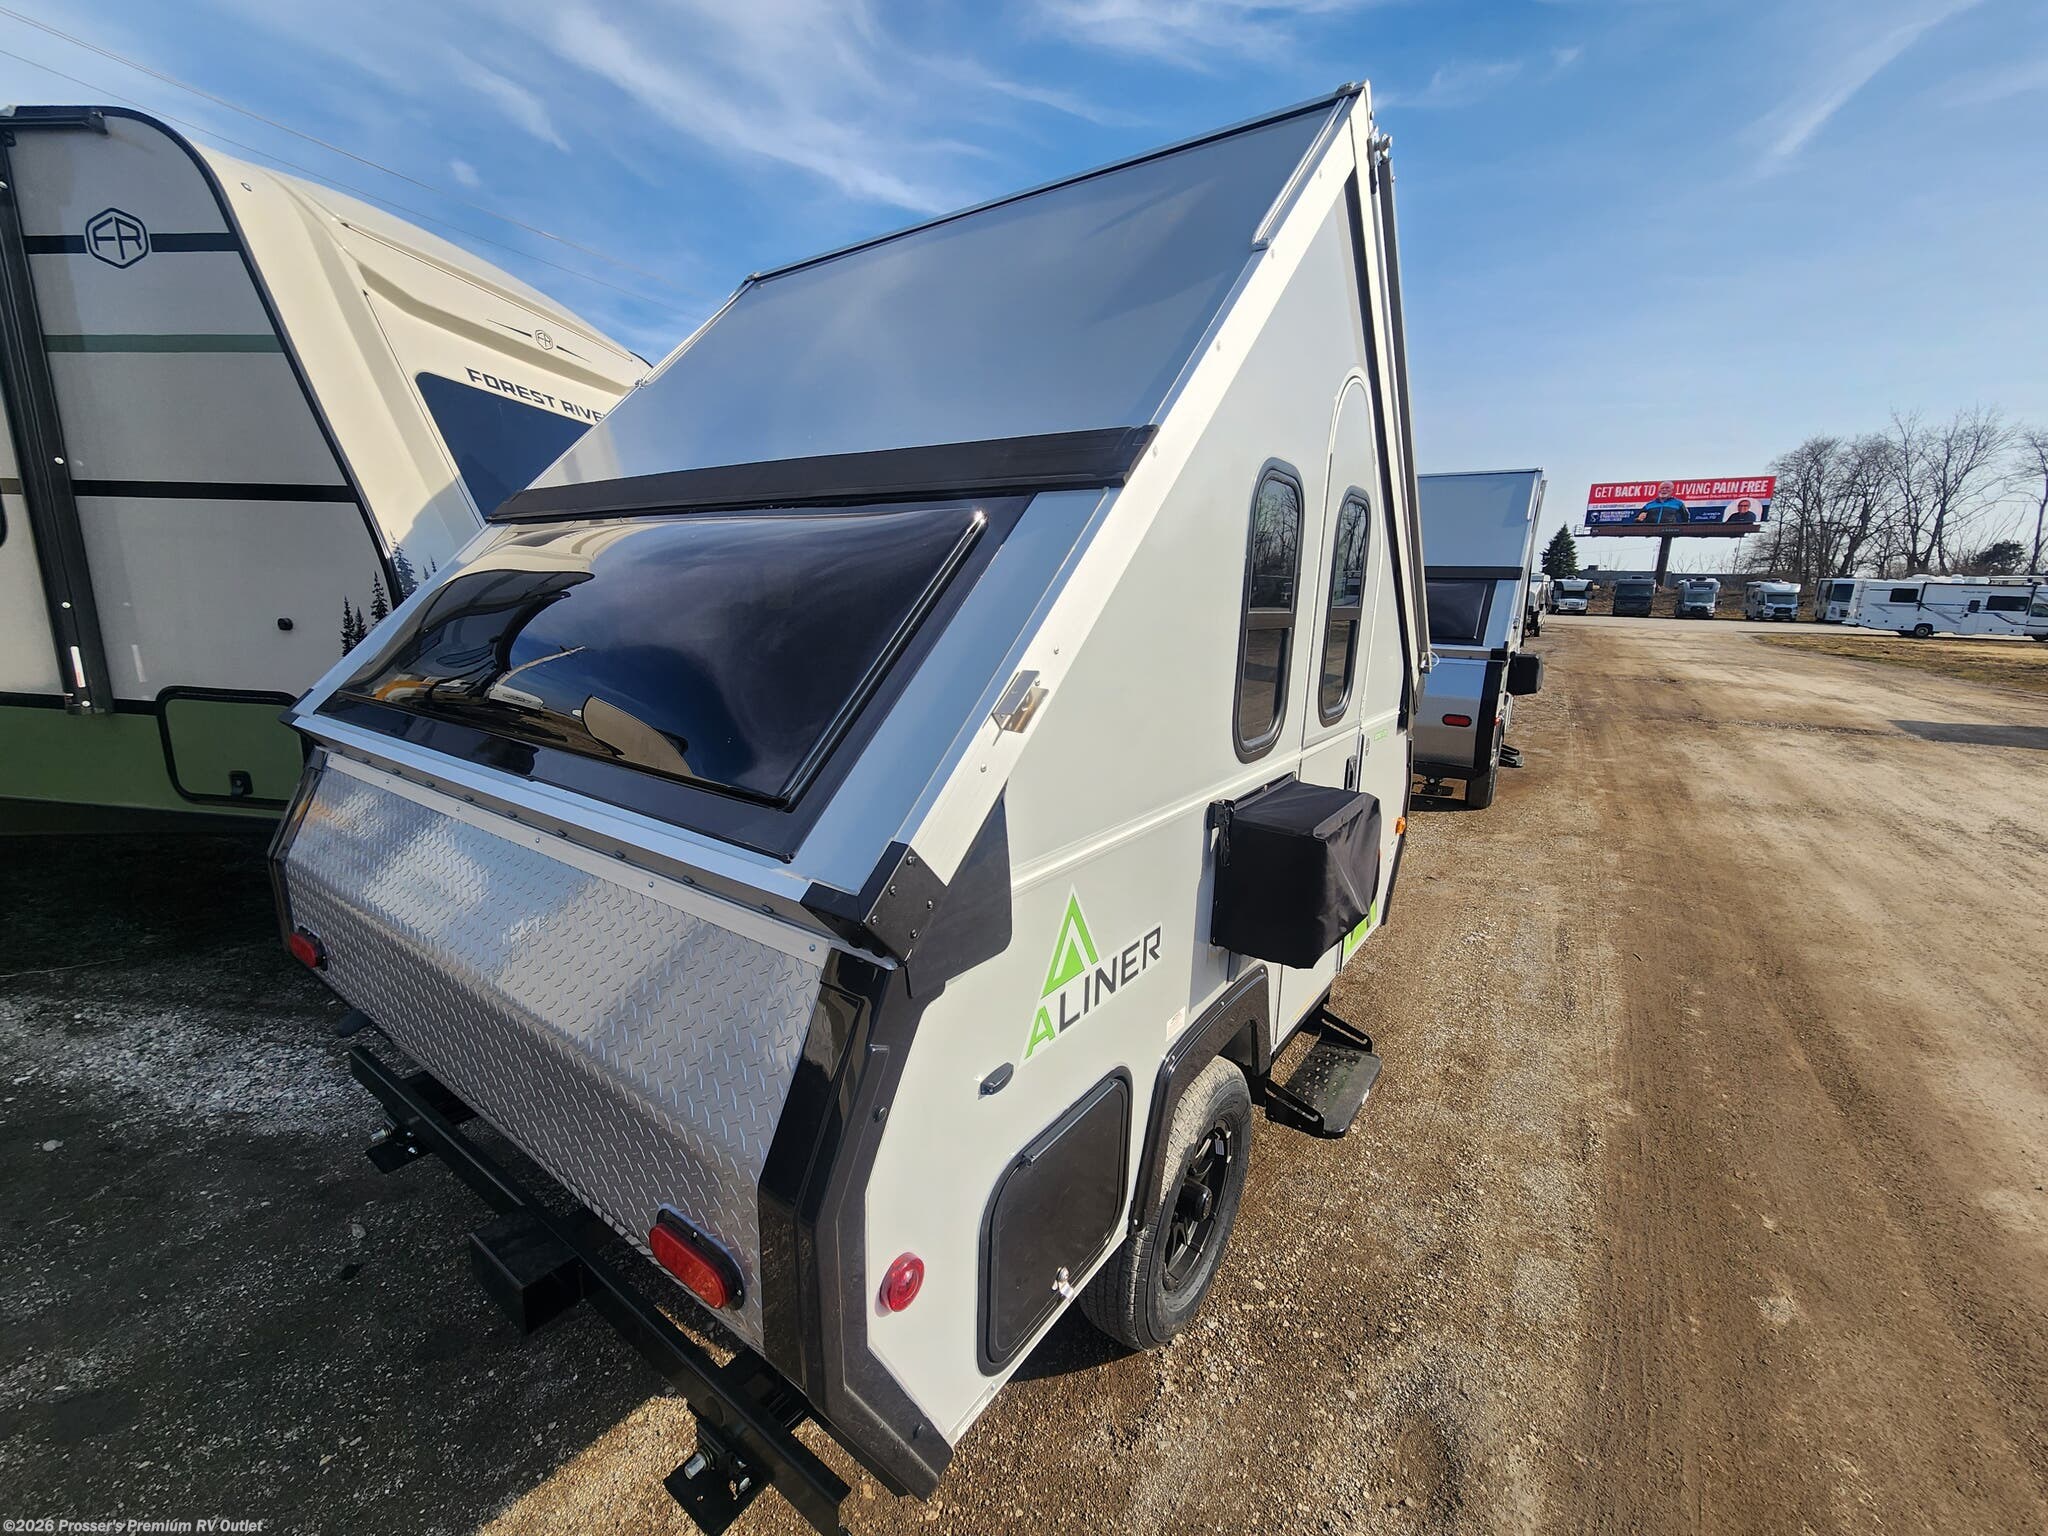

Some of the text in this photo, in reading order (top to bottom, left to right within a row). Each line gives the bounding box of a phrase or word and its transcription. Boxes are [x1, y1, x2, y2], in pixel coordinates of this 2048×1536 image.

[465, 367, 606, 422] FOREST RIVE
[1595, 486, 1613, 498] GET
[1614, 485, 1642, 497] BACK
[1643, 484, 1657, 496] TO
[1675, 482, 1711, 496] LIVING
[1712, 481, 1738, 494] PAIN
[1740, 480, 1769, 493] FREE
[1025, 925, 1162, 1060] ALINER
